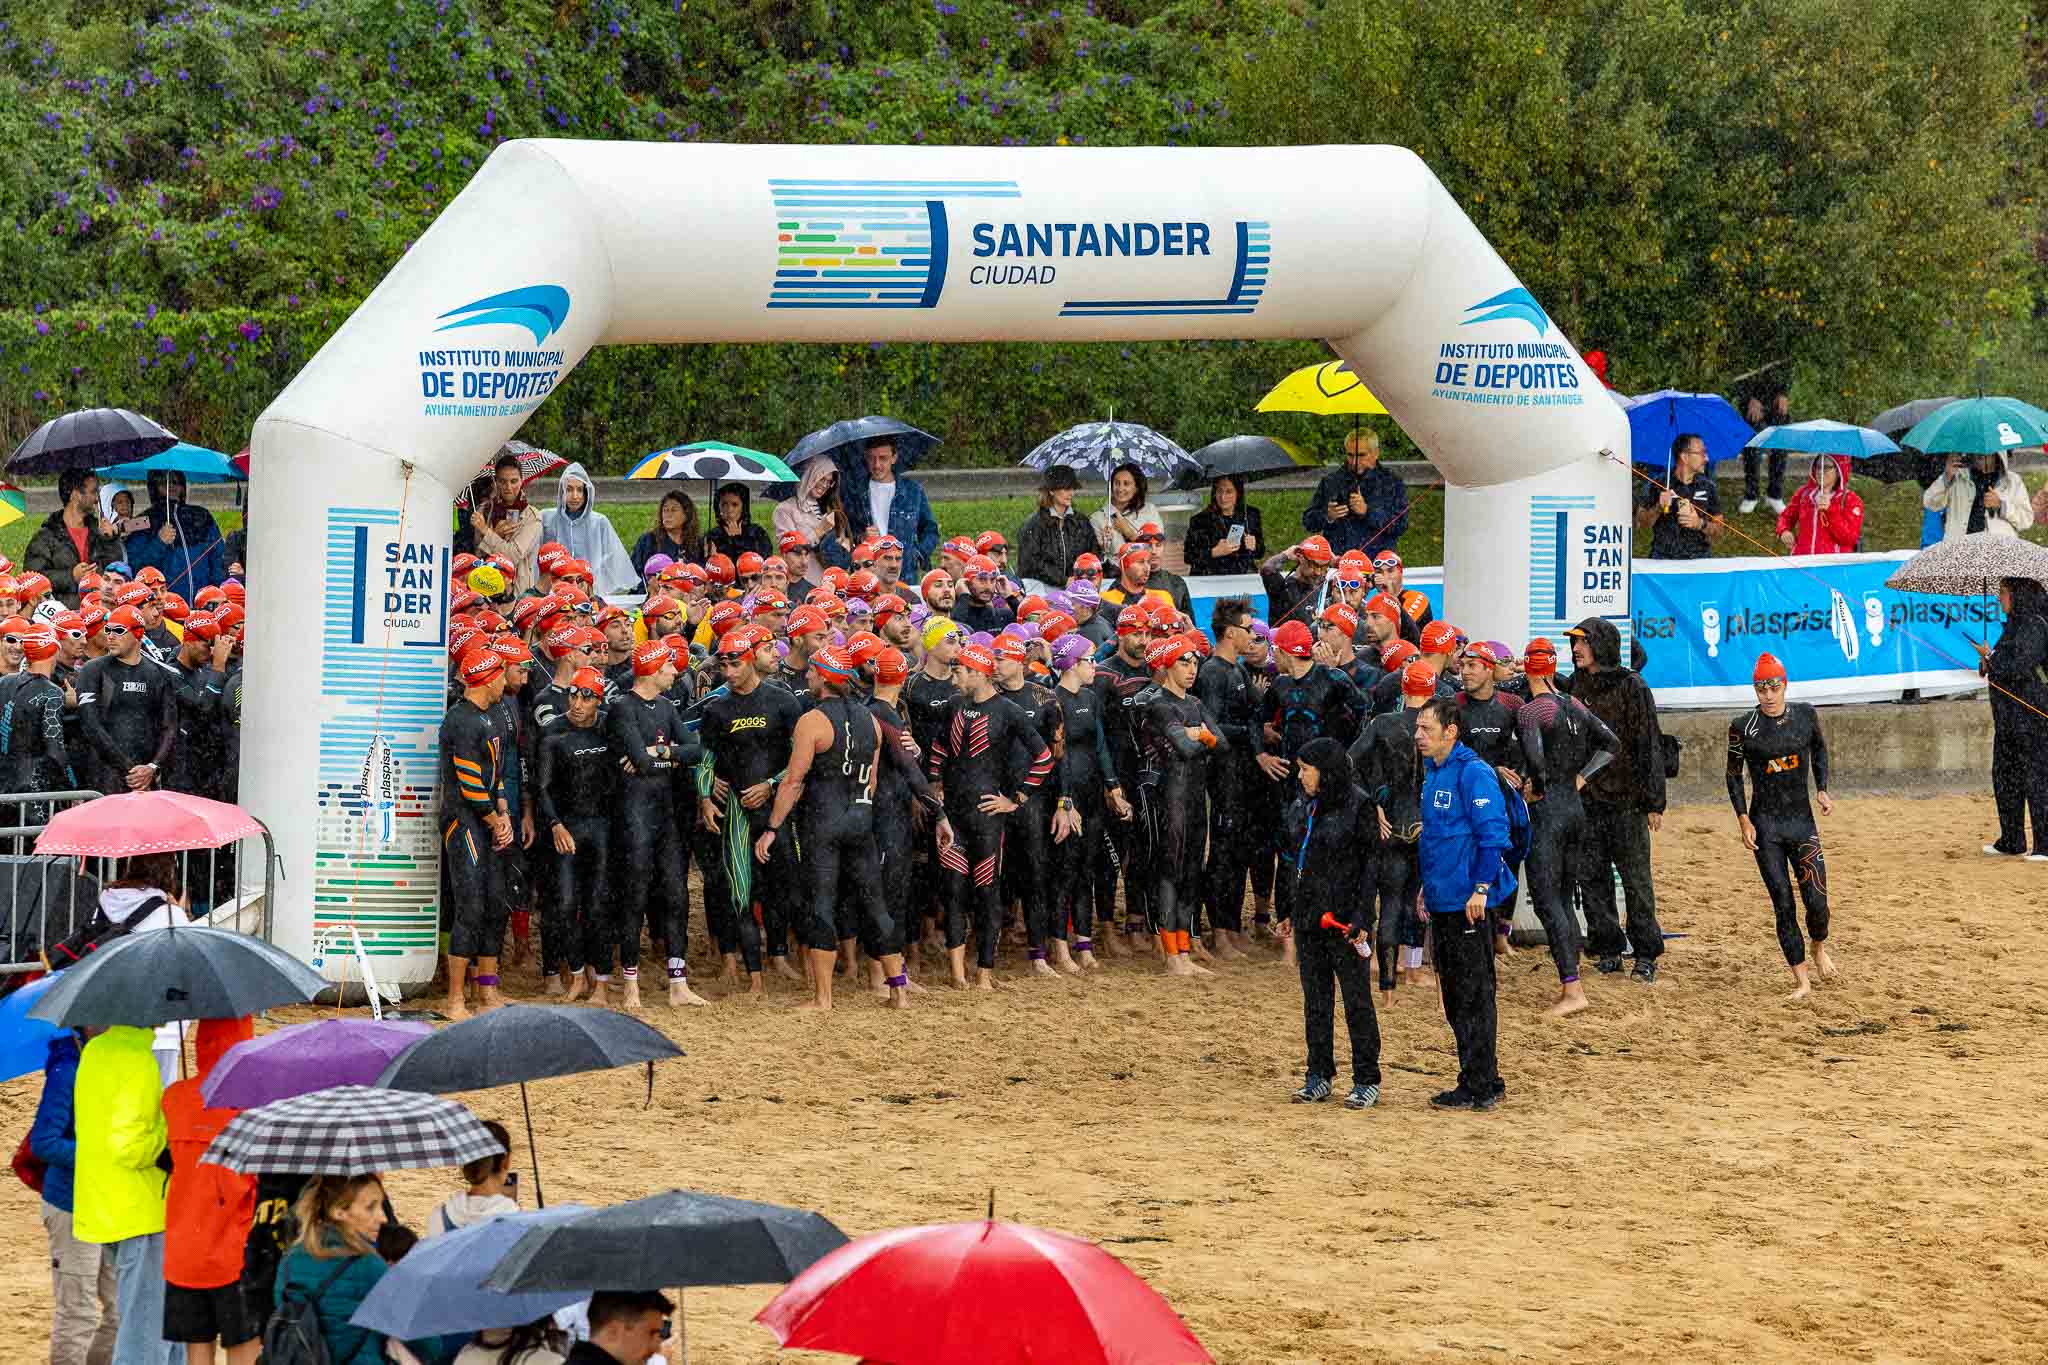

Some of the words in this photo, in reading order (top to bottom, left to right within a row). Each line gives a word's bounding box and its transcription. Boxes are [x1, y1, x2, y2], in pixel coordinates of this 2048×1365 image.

[971, 222, 1211, 257] SANTANDER
[969, 264, 1056, 286] CIUDAD
[419, 350, 500, 367] INSTITUTO
[504, 351, 565, 367] MUNICIPAL
[1439, 343, 1514, 359] INSTITUTO
[1517, 344, 1571, 360] MUNICIPAL
[422, 371, 456, 398] DE
[462, 370, 559, 399] DEPORTES
[1435, 362, 1469, 386] DE
[1474, 363, 1579, 389] DEPORTES
[1431, 388, 1514, 406] AYUNTAMIENTO
[1517, 395, 1529, 406] DE
[1532, 394, 1584, 406] SANTANDER
[424, 403, 497, 417] AYUNTAMIENTO
[500, 404, 510, 416] DE
[1583, 524, 1623, 544] SAN
[385, 542, 433, 564] SAN
[1583, 548, 1622, 567] TAN
[385, 567, 433, 590] TAN
[1583, 571, 1622, 590] DER
[384, 592, 432, 614] DER
[1583, 595, 1614, 604] CIUDAD
[42, 604, 56, 617] 16
[383, 618, 421, 629] CIUDAD
[729, 716, 767, 734] ZOGGS
[574, 746, 607, 756] orca
[381, 747, 392, 800] plaspisa
